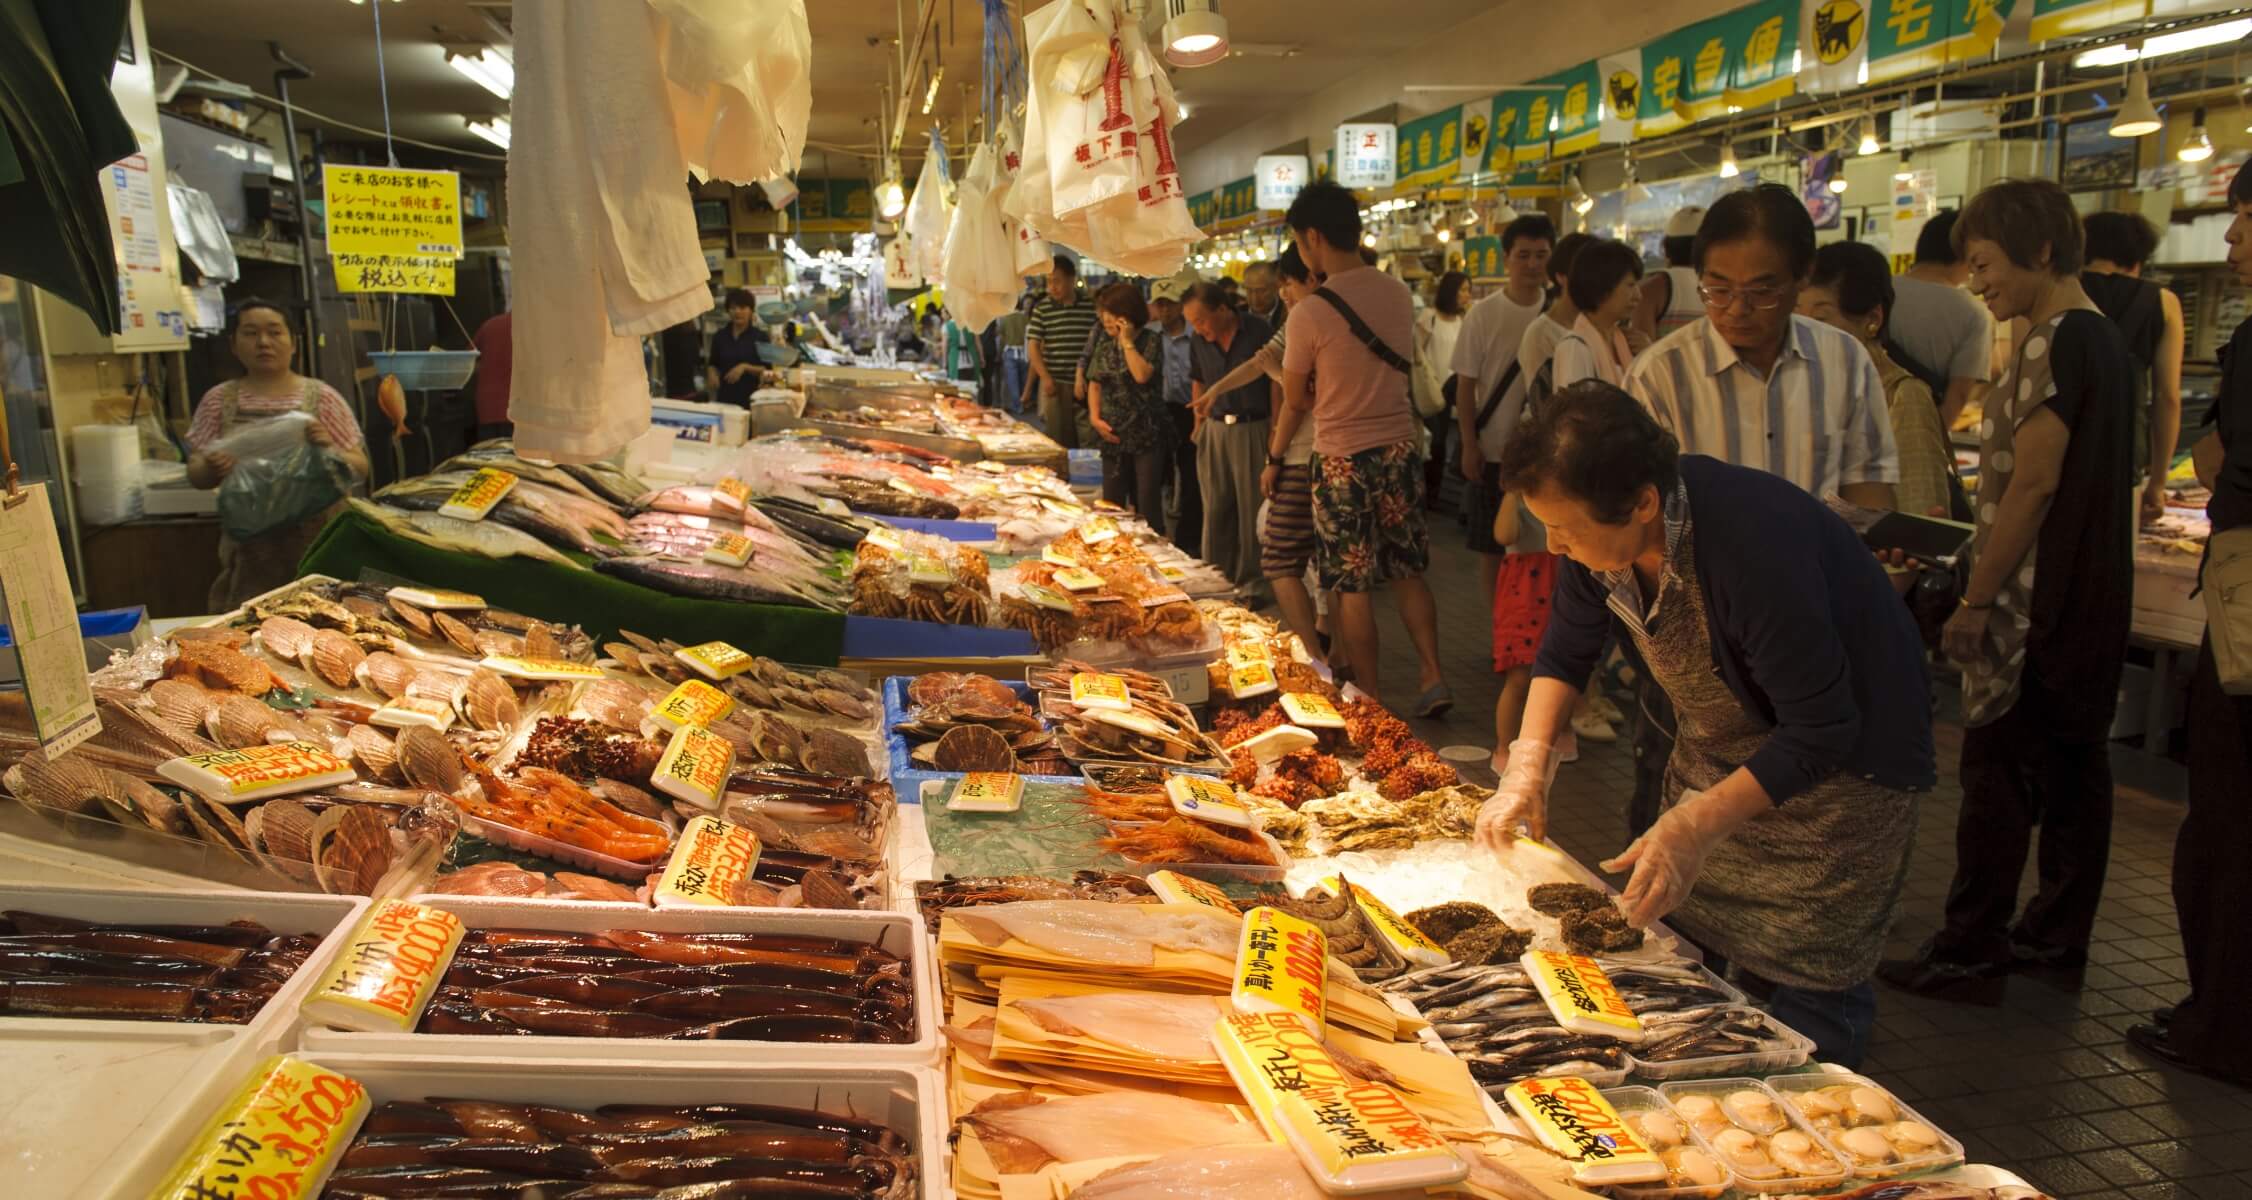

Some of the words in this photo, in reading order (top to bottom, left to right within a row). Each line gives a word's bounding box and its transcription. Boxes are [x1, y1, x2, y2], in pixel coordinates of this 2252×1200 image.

[339, 173, 443, 190] ご来店のお客様へ
